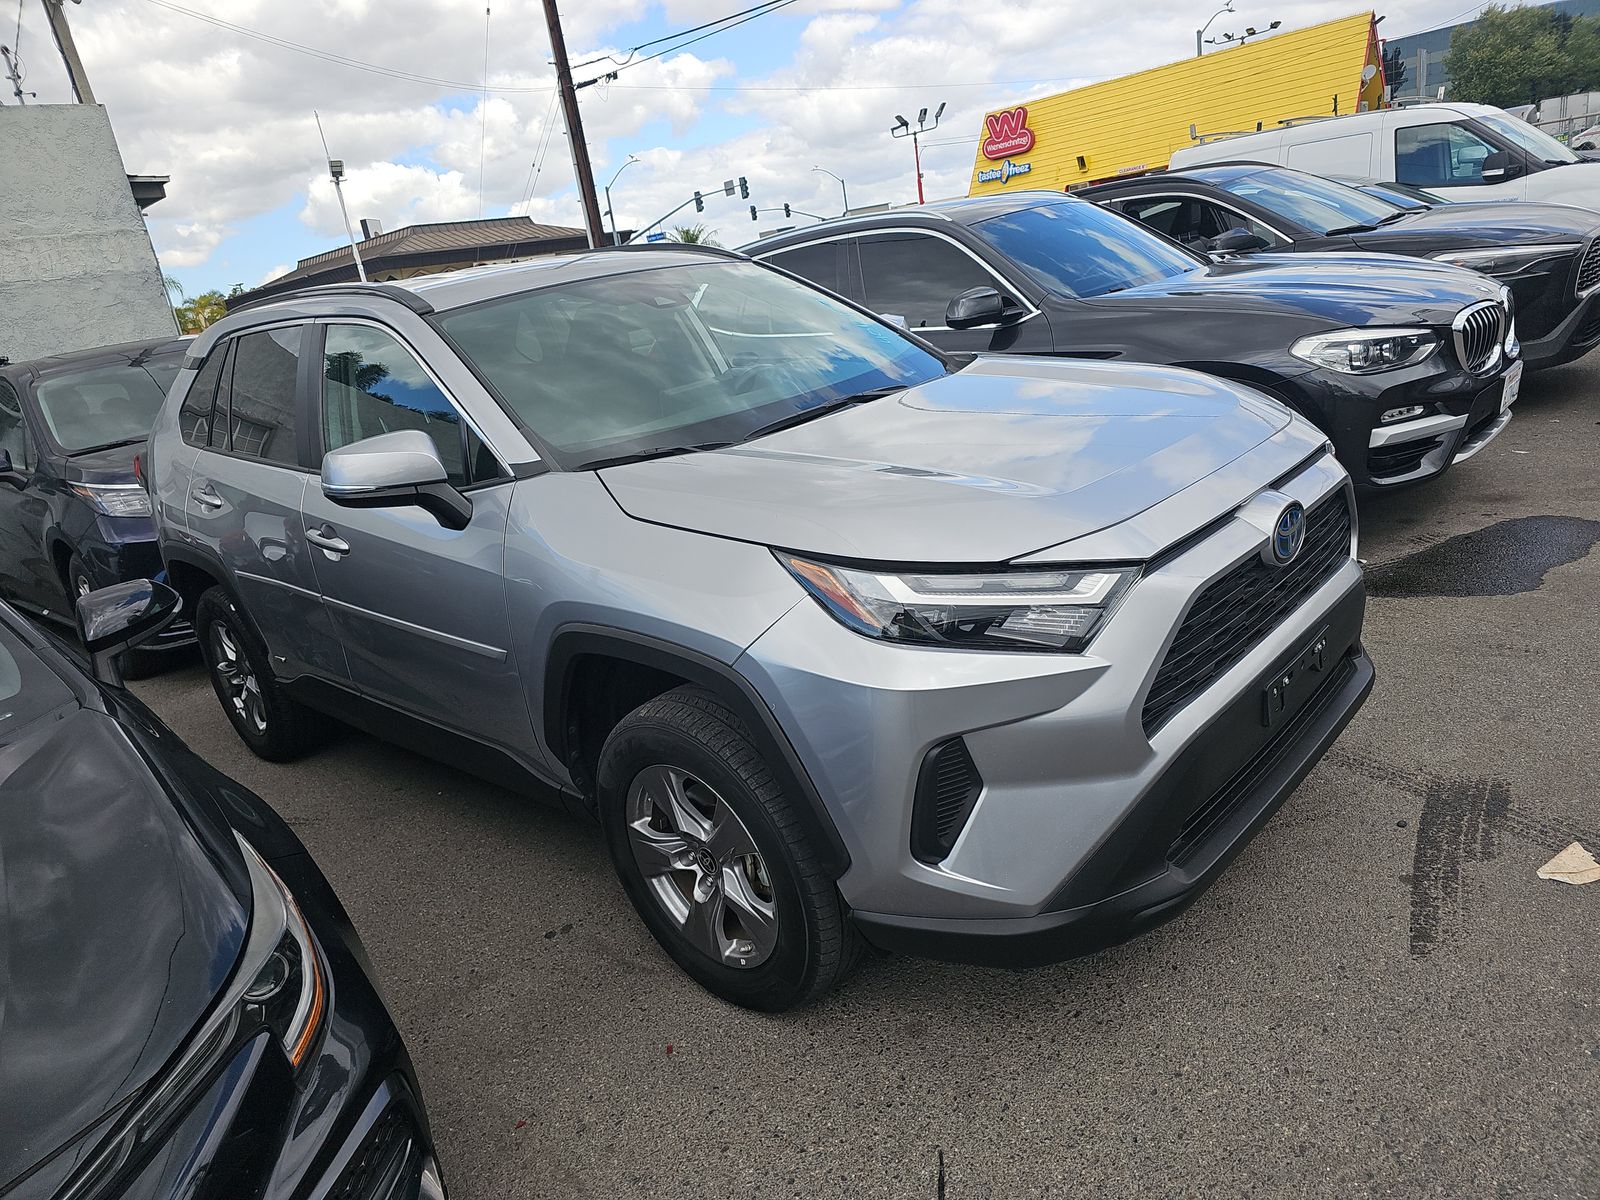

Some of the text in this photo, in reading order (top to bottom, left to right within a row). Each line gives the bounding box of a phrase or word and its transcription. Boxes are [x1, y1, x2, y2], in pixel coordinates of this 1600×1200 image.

[987, 108, 1025, 141] W
[987, 136, 1029, 152] Wienerschnitzel
[978, 163, 1031, 182] tastee freez
